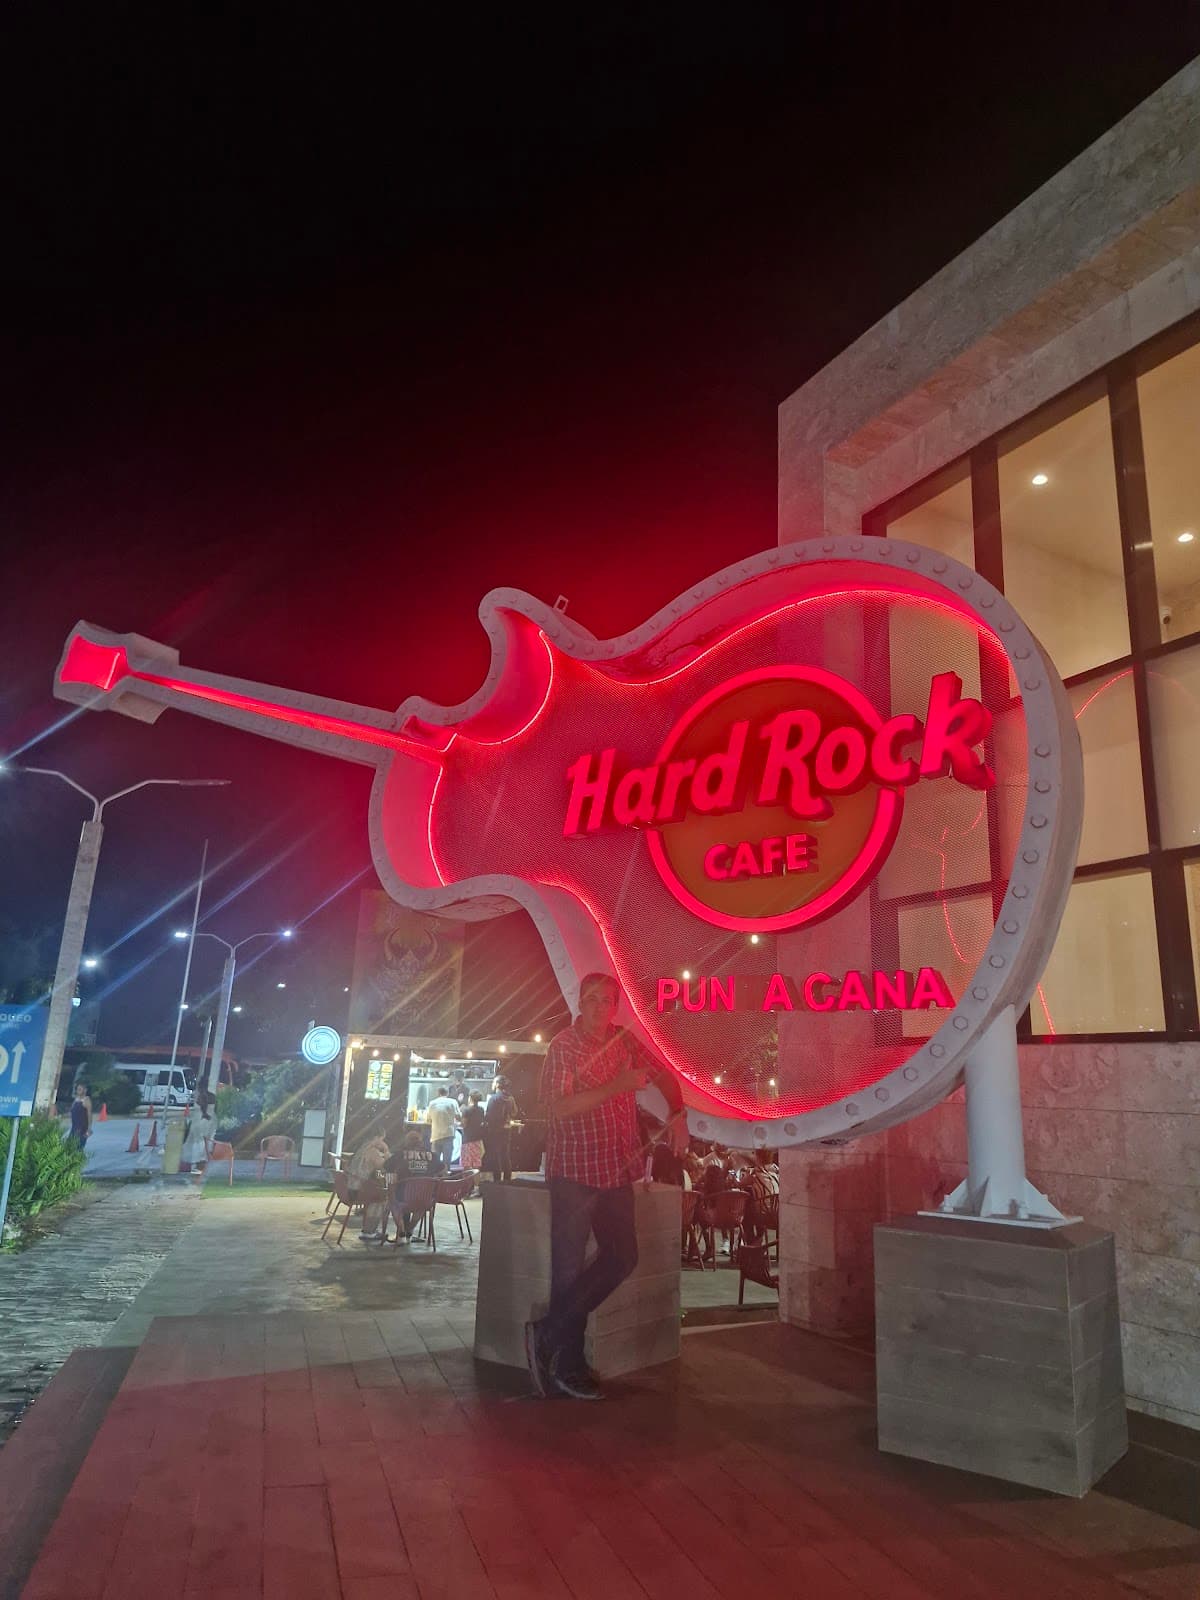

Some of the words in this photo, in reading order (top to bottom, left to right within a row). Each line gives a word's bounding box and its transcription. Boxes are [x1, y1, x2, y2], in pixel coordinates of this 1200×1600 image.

[562, 719, 750, 839] Hard
[757, 671, 996, 820] Rock
[704, 833, 818, 881] CAFE
